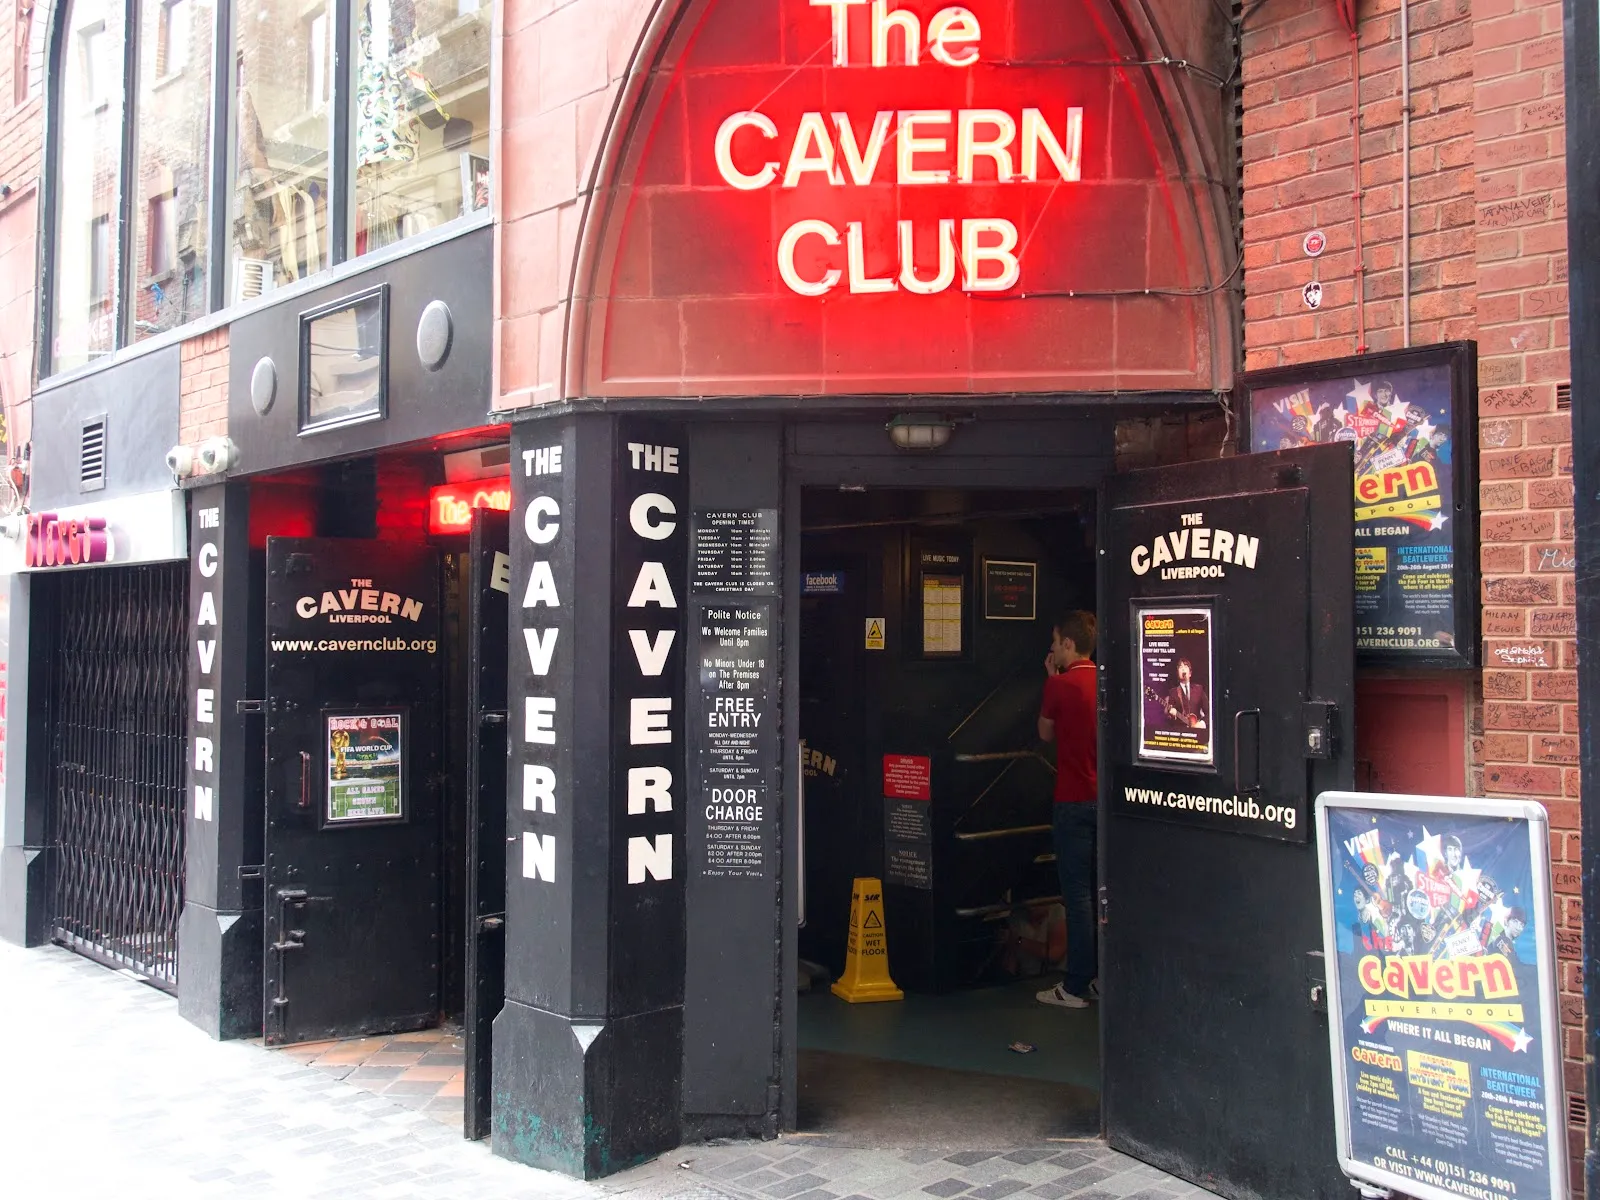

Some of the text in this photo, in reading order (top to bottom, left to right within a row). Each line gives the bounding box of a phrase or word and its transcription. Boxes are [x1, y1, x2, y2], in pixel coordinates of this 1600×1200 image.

[808, 0, 982, 67] The
[714, 106, 1084, 190] CAVERN
[777, 217, 1021, 297] CLUB
[1273, 388, 1310, 414] VISIT
[522, 446, 562, 476] THE
[627, 442, 679, 474] THE
[199, 507, 220, 528] THE
[1181, 513, 1203, 526] THE
[1355, 526, 1410, 536] ALL BEGAN
[922, 554, 931, 562] LIVE
[932, 554, 945, 562] MUSIC
[1131, 528, 1259, 576] CAVERN
[1397, 546, 1453, 555] INTERNATIONAL
[1402, 554, 1448, 564] BEATLEWEEK
[806, 573, 838, 585] facebook
[1161, 565, 1225, 580] LIVERPOOL
[351, 579, 372, 587] THE
[296, 589, 424, 622] CAVERN
[329, 615, 392, 623] LIVERPOOL
[708, 610, 761, 620] Polite Notice
[1145, 619, 1174, 629] cavern
[1377, 627, 1395, 635] 236
[1398, 627, 1422, 635] 9091
[1487, 623, 1520, 633] LEWIS
[702, 627, 768, 637] We Welcome Families
[271, 637, 437, 653] www.cavernclub.org
[720, 638, 749, 648] Until 8pm
[1357, 638, 1440, 647] AVERNCLUB.ORG
[704, 659, 765, 668] No Minors Under 18
[194, 542, 218, 822] CAVERN
[709, 670, 760, 679] on The Premises
[522, 496, 560, 883] CAVERN
[627, 493, 677, 884] CAVERN
[719, 681, 749, 691] After 8pm
[715, 697, 754, 712] FREE
[330, 718, 359, 731] ROCK
[709, 712, 761, 727] ENTRY
[712, 788, 757, 804] DOOR
[705, 805, 763, 821] CHARGE
[1124, 786, 1296, 829] www.cavernclub.org
[1343, 828, 1379, 856] VISIT
[1360, 956, 1517, 997] cavern
[1372, 1004, 1514, 1017] LIVERPOOL
[1387, 1020, 1491, 1051] WHERE IT ALL BEGAN
[1352, 1046, 1403, 1071] cavern
[1480, 1067, 1542, 1088] INTERNATIONAL
[1486, 1080, 1536, 1099] BEATLEWEEK
[1509, 1097, 1544, 1110] August 2014
[1373, 1156, 1387, 1169] OR
[1388, 1160, 1412, 1177] VISIT
[1385, 1146, 1516, 1194] CALL +44 (0)151 236 9091
